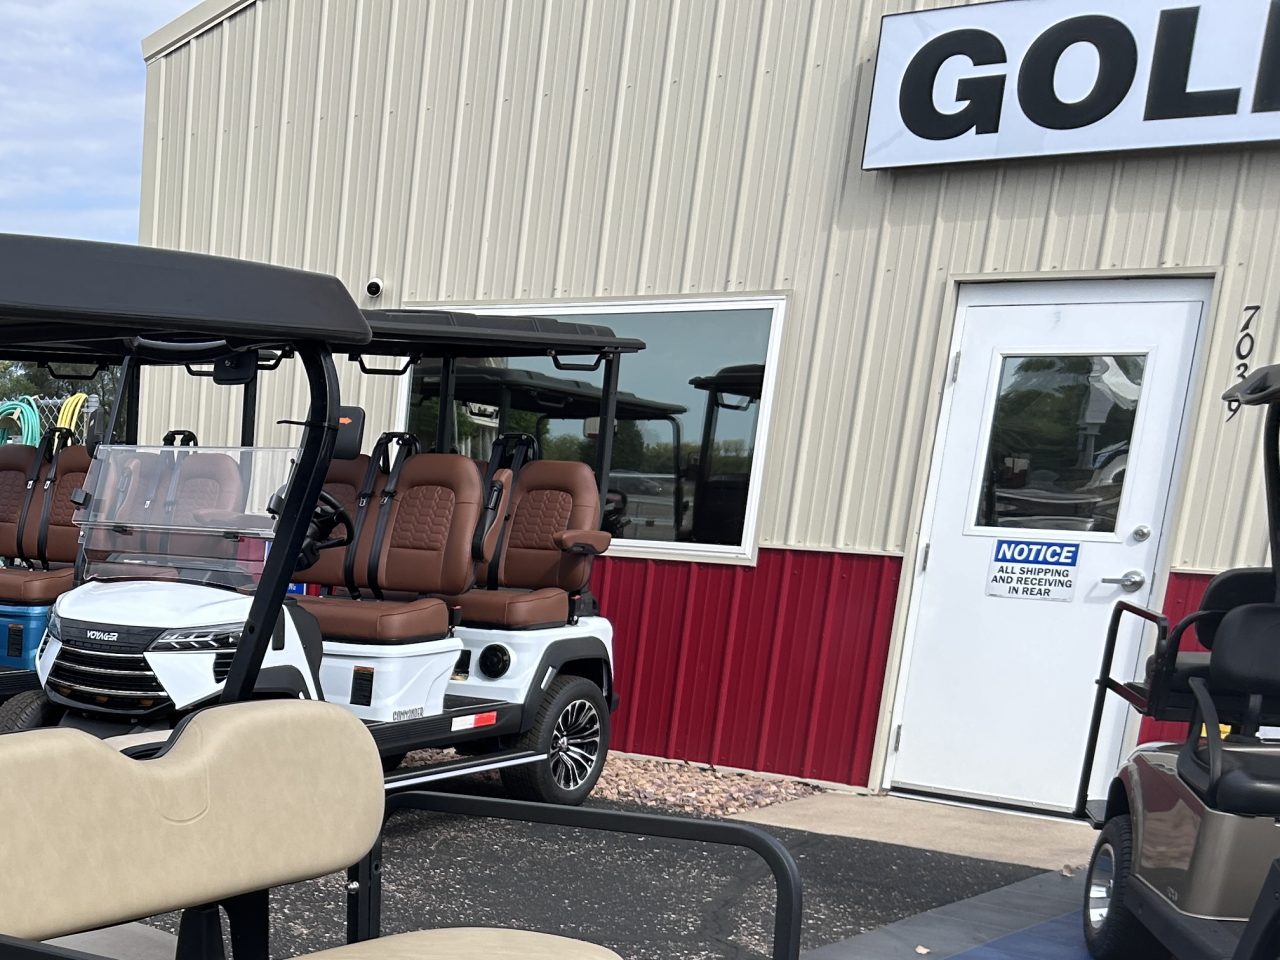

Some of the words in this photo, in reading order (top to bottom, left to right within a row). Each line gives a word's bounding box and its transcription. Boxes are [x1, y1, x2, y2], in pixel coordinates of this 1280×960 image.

[899, 2, 1280, 141] GOL
[998, 543, 1076, 563] NOTICE
[997, 565, 1017, 575] ALL
[1019, 566, 1070, 578] SHIPPING
[991, 575, 1014, 585] AND
[1016, 576, 1073, 589] RECEIVING
[1008, 586, 1019, 595] IN
[1022, 587, 1051, 597] REAR
[86, 630, 119, 641] VOYAGER
